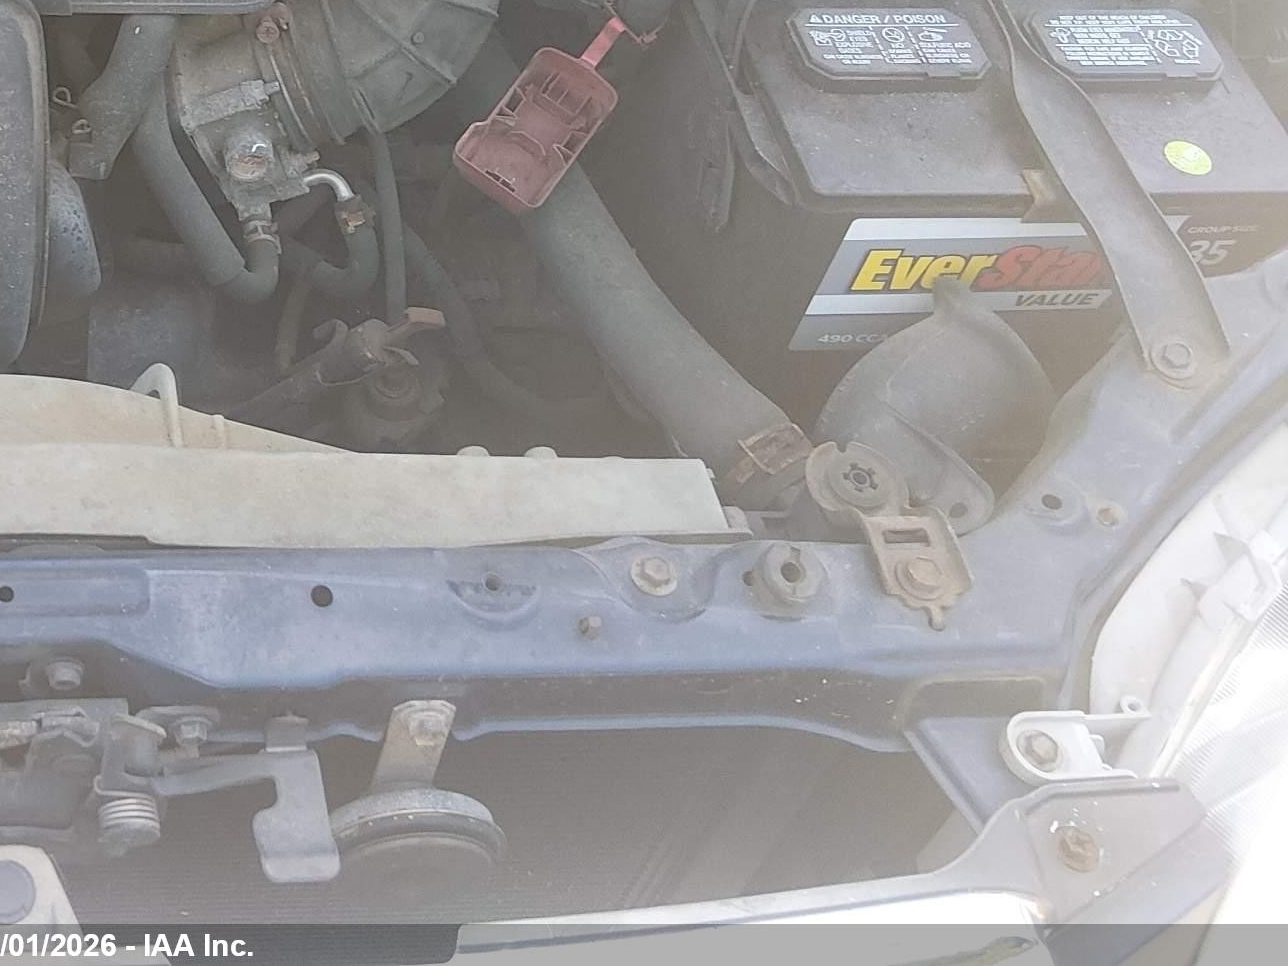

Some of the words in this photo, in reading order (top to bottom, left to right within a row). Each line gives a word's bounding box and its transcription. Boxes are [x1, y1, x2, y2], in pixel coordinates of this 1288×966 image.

[821, 14, 882, 24] DANGER
[893, 14, 947, 24] POISON
[1015, 293, 1099, 307] VALUE
[817, 334, 853, 343] 490
